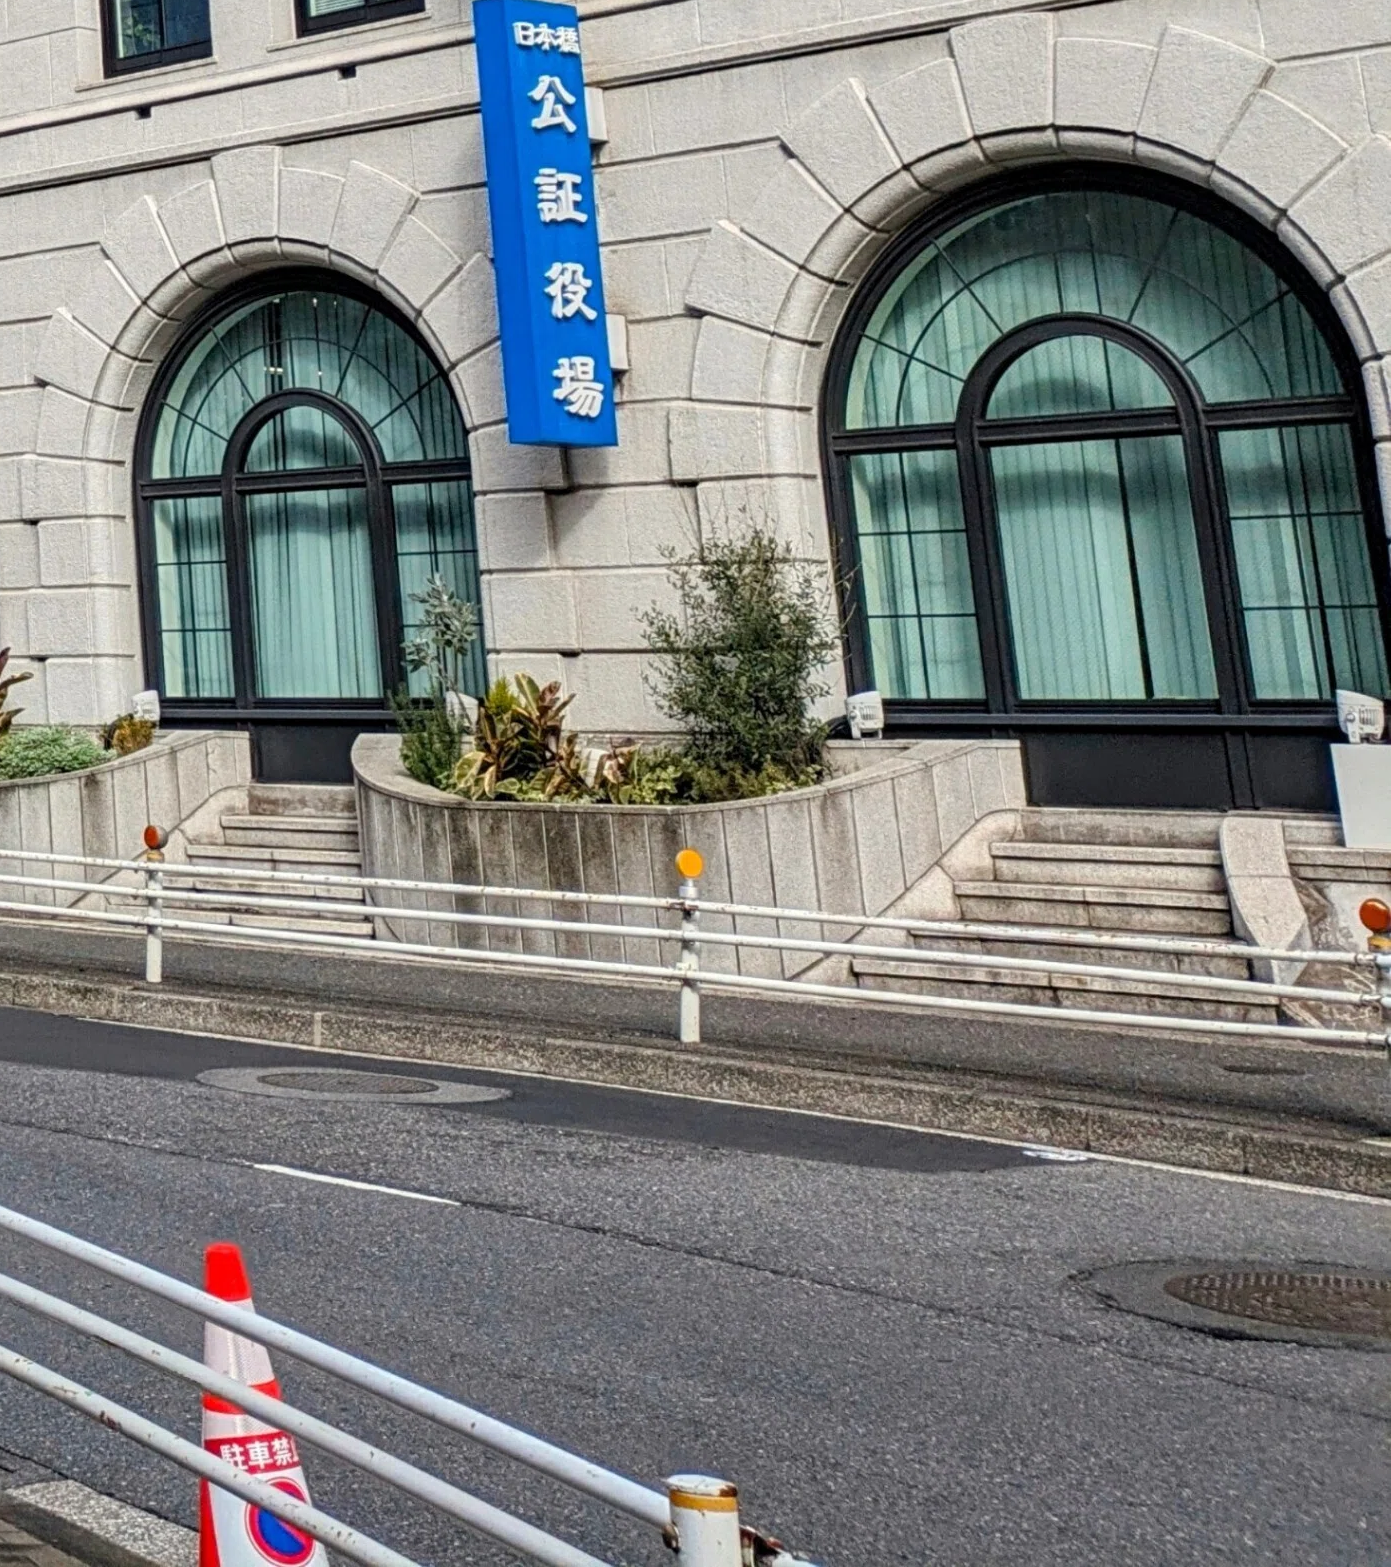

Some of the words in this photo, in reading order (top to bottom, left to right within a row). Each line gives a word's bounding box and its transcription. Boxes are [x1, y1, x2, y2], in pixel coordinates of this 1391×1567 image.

[512, 21, 581, 54] 日本橋
[528, 74, 605, 419] 公証役場
